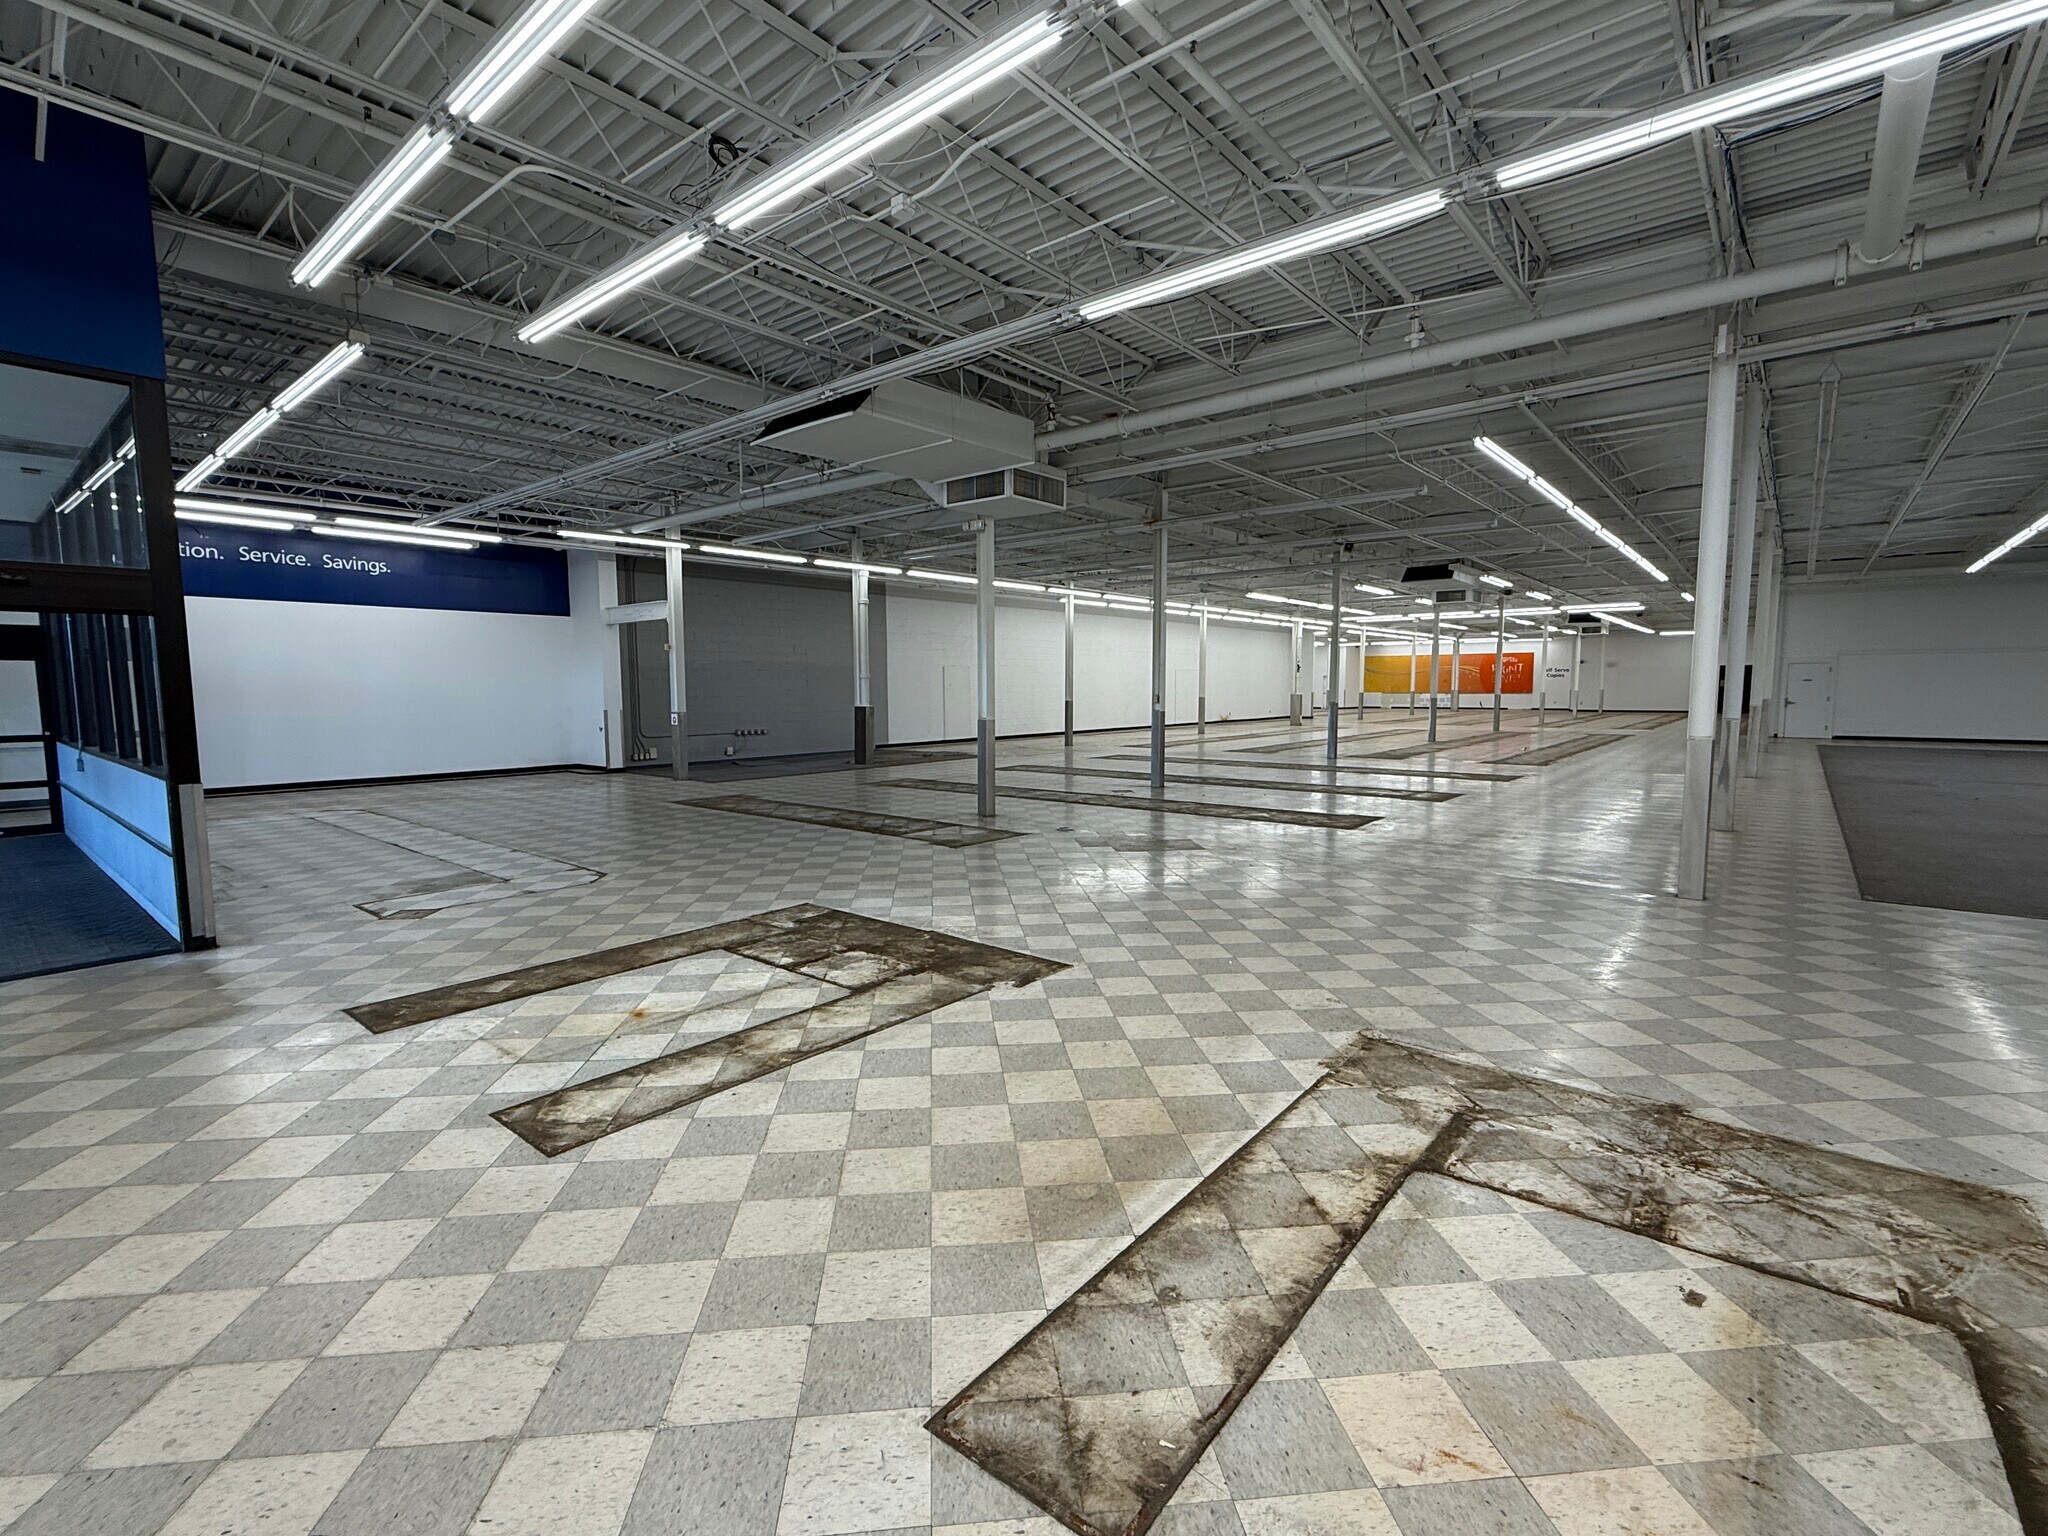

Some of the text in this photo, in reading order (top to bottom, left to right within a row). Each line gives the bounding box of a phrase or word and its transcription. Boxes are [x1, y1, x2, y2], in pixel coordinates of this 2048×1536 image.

[178, 541, 391, 575] tion. Service. Savings.
